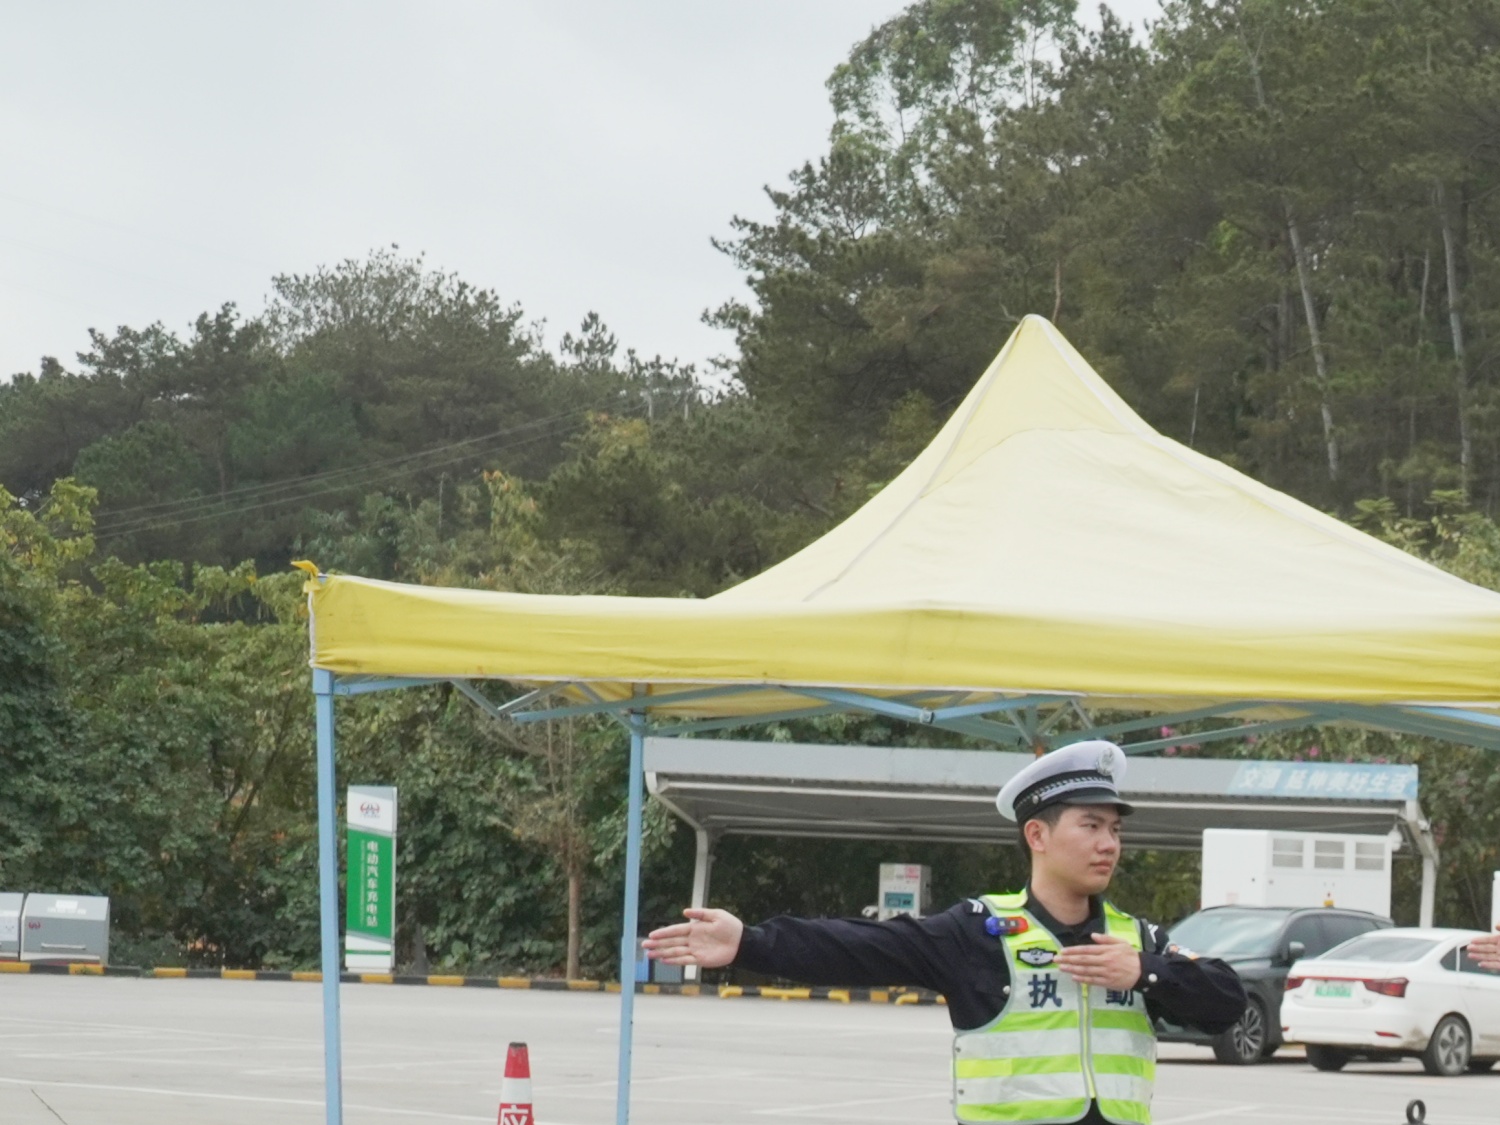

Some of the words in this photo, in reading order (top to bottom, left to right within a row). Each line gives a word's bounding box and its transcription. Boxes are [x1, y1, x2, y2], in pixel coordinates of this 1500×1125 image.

[366, 840, 379, 928] 电动汽车充电站
